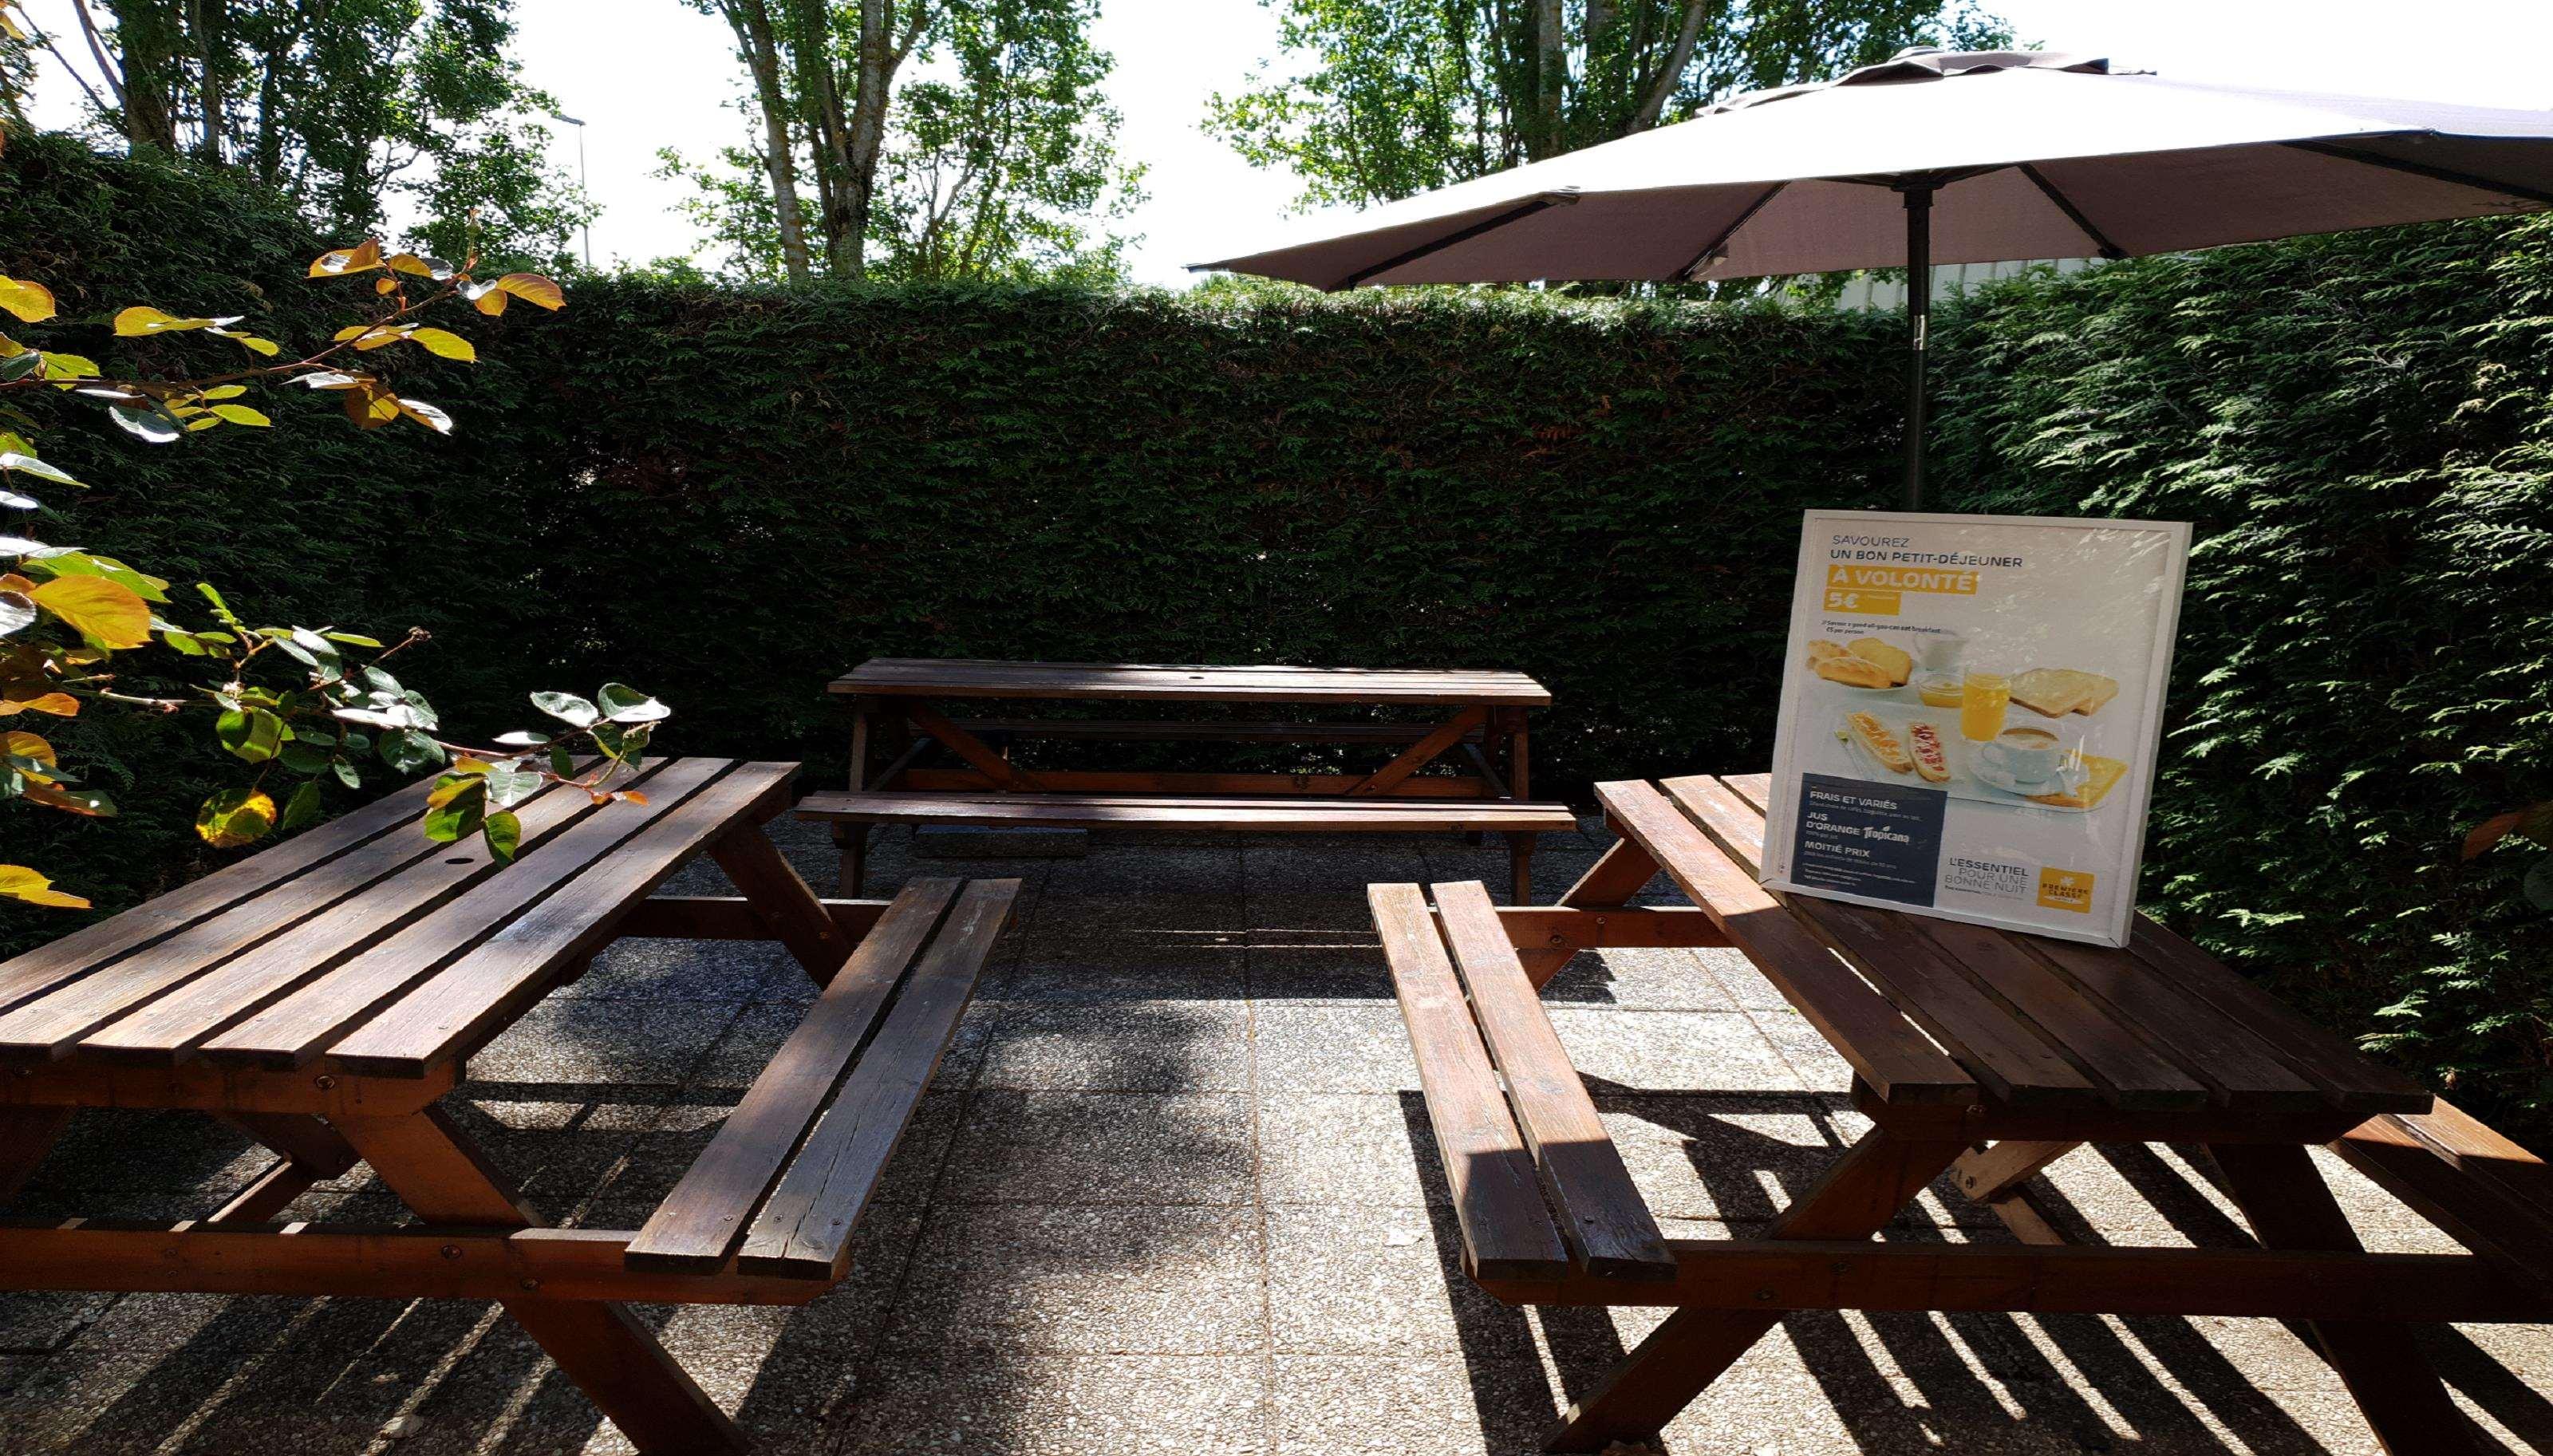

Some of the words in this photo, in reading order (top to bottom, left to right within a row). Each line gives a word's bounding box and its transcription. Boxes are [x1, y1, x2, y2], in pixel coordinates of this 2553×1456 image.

[1832, 535, 1910, 548] SAVOUREZ
[1830, 549, 1851, 559] UN
[1856, 550, 1888, 562] BON
[1892, 552, 2023, 567] PETIT-DÉJEUNER
[1832, 566, 1850, 583] À
[1828, 592, 1860, 609] 5€
[1809, 791, 1840, 802] FRAIS
[1858, 798, 1897, 810] VARIÉS
[1807, 811, 1828, 821] JUS
[1805, 821, 1860, 835] D'ORANGE
[1864, 827, 1910, 843] Tropicana
[1805, 840, 1843, 854] MOITIÉ
[1845, 846, 1871, 858] PRIX
[1949, 857, 2030, 877] L'ESSENTIEL
[1944, 874, 1991, 890] BONNE
[1995, 882, 2027, 894] NUIT
[1959, 867, 1995, 881] POUR
[1999, 873, 2029, 886] UNE
